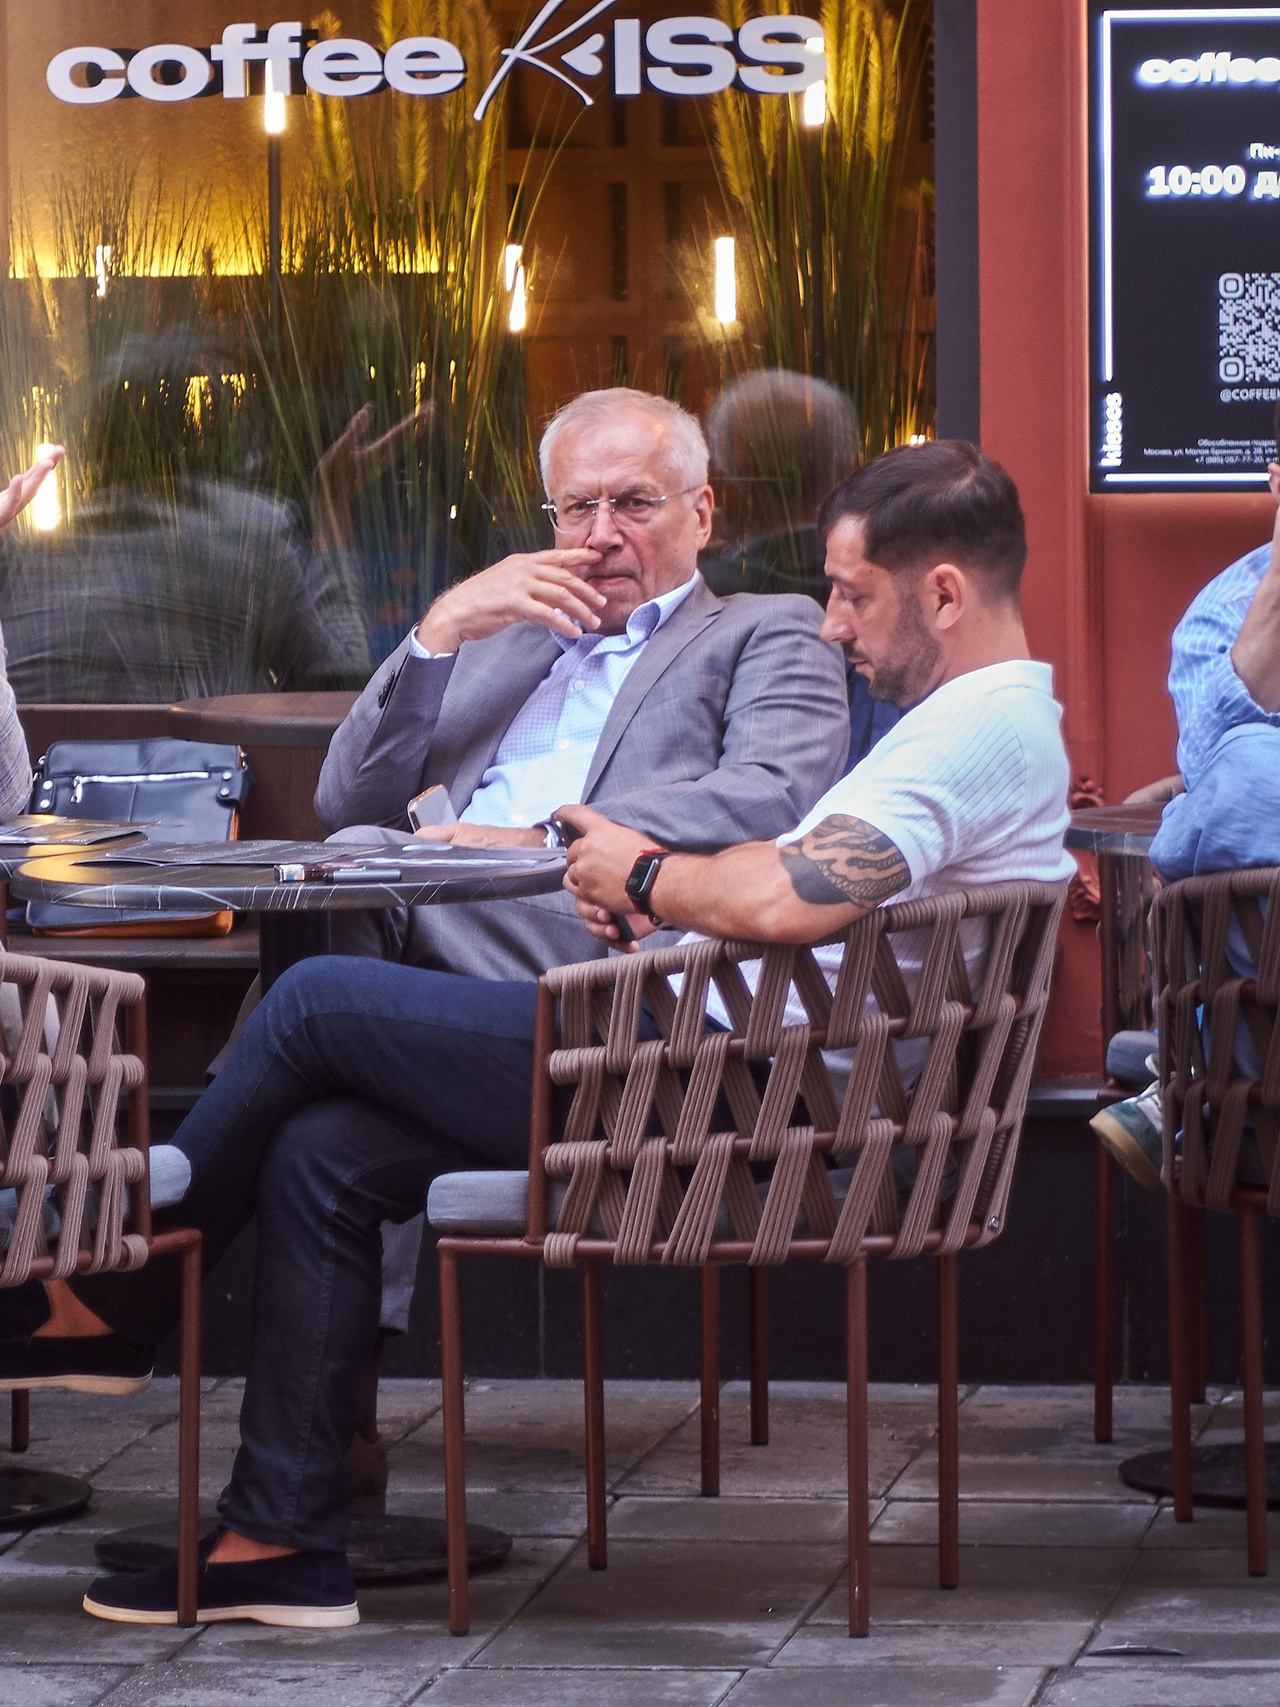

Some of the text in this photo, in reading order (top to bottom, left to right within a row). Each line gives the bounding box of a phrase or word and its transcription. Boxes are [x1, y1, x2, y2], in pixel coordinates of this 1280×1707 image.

[46, 23, 465, 104] coffee
[1149, 165, 1280, 198] 10:00 д
[1101, 392, 1122, 466] kisses
